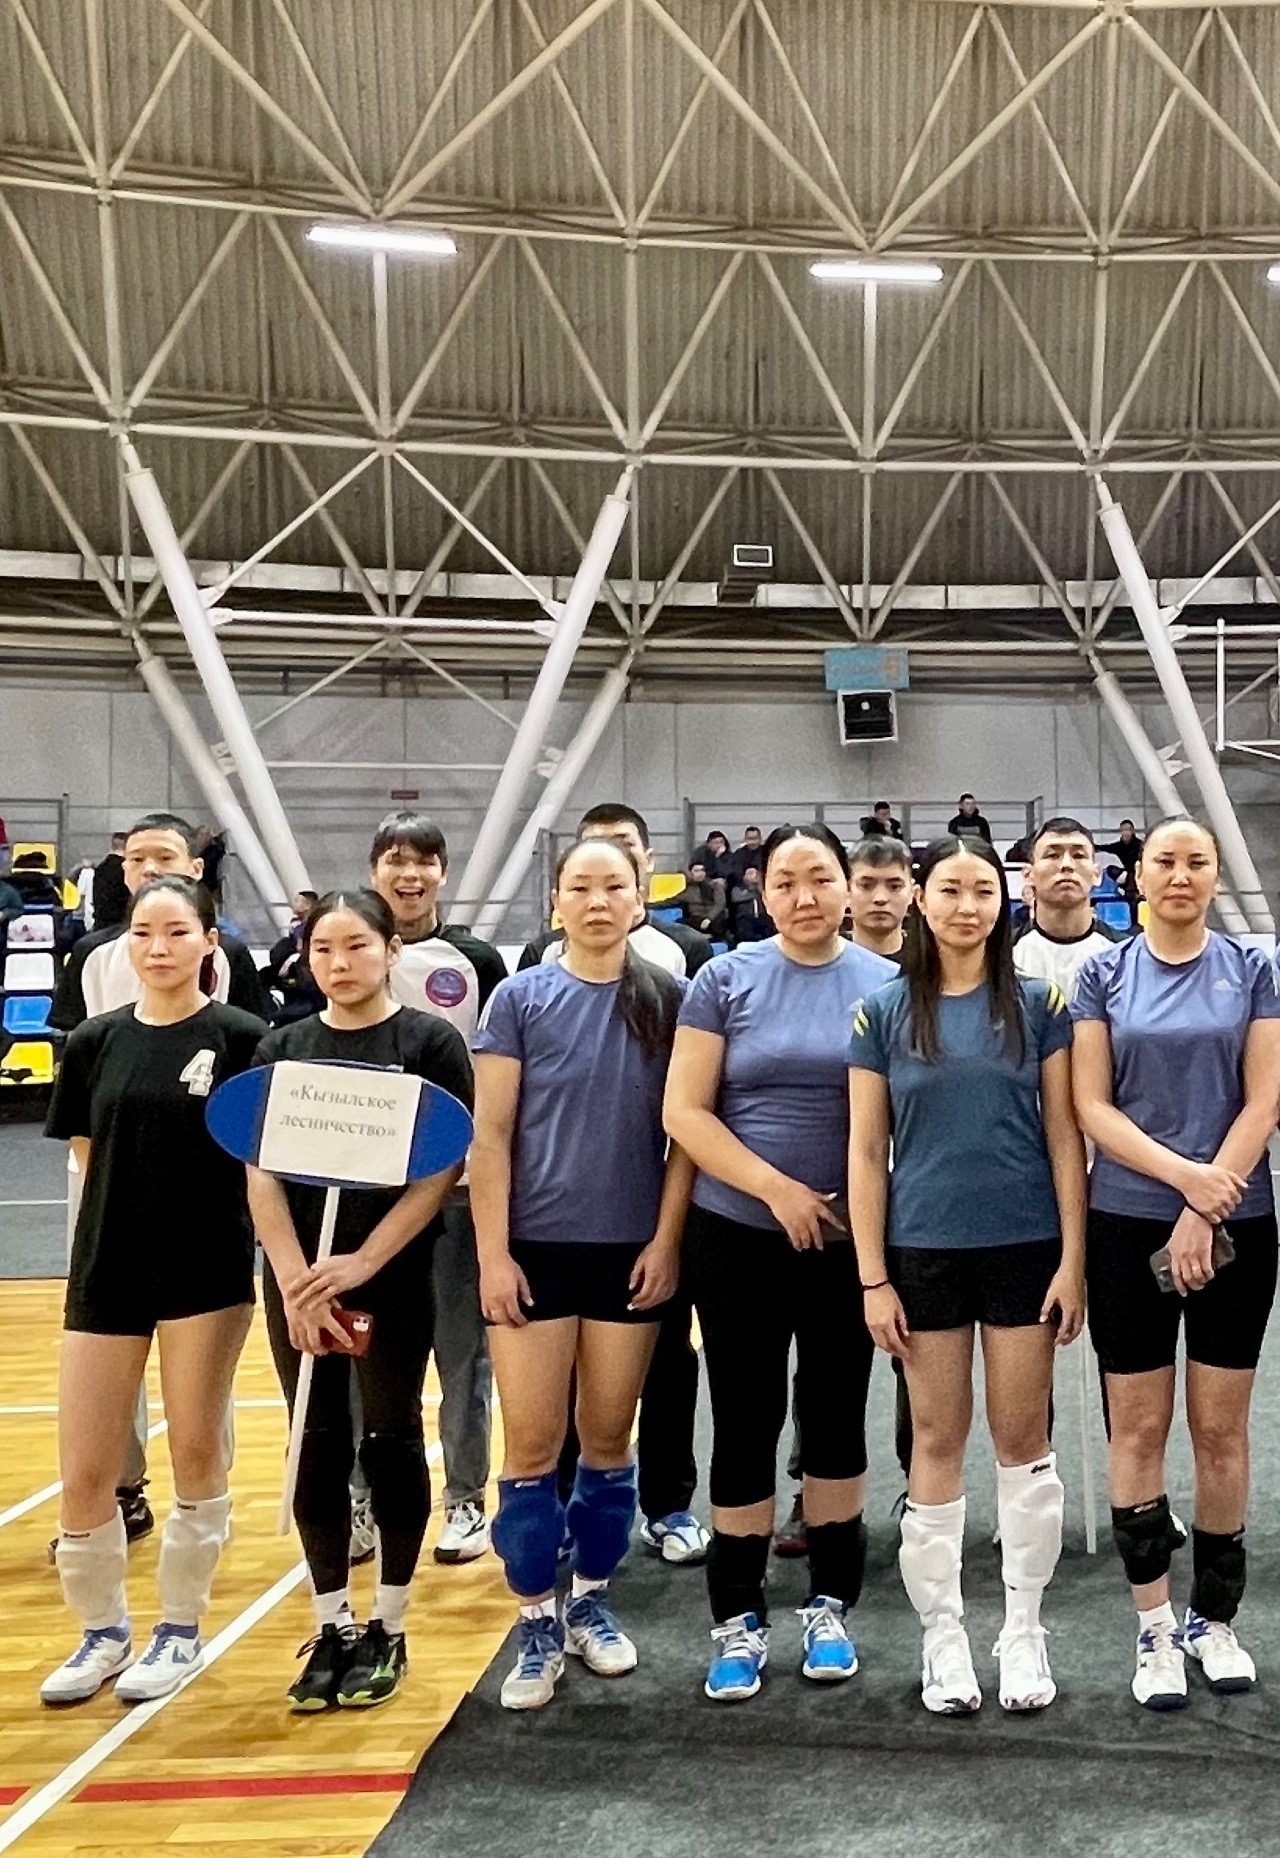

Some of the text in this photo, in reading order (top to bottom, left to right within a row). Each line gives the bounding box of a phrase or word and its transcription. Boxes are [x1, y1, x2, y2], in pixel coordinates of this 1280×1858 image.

[179, 1049, 217, 1097] 4
[289, 1084, 397, 1111] «Кызылское
[279, 1113, 397, 1138] лесничество»
